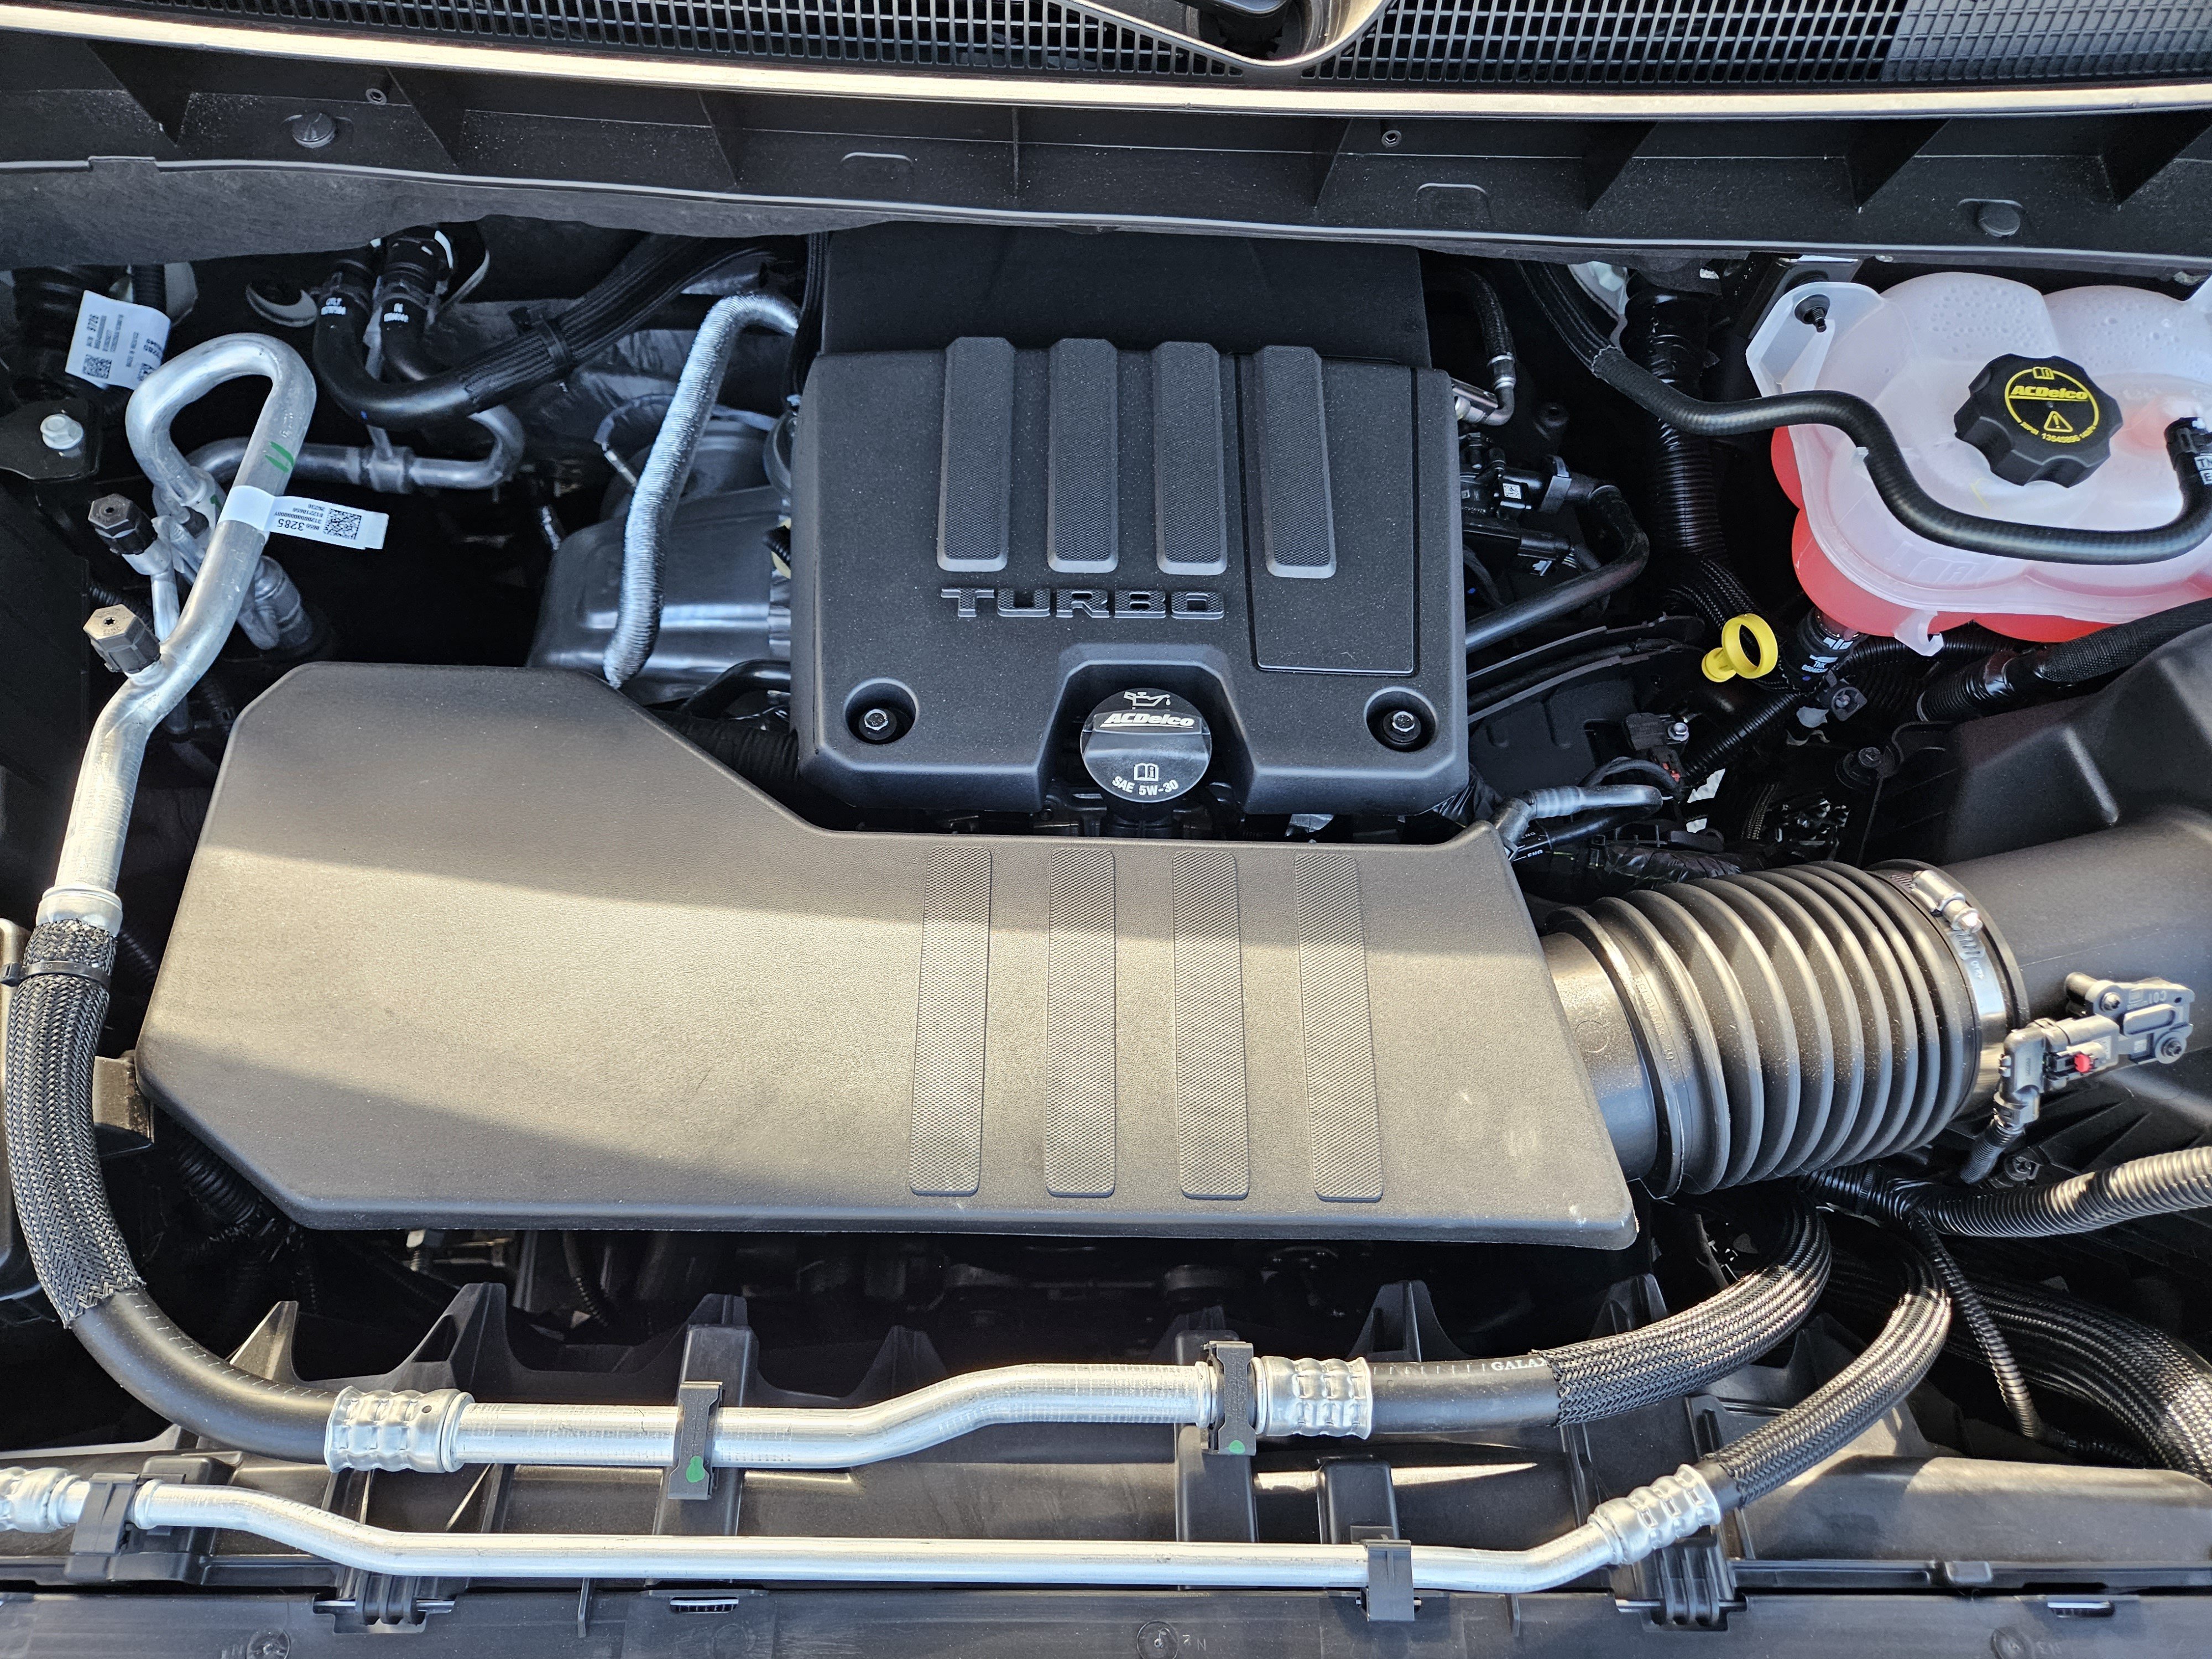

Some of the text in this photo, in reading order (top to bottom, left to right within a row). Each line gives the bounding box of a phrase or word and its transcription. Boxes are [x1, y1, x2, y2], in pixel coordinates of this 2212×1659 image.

[2010, 385, 2088, 400] ACDelco
[277, 518, 305, 531] 3285
[941, 587, 1224, 620] TURBO
[1104, 713, 1195, 727] ACDelco
[1112, 776, 1179, 796] SAE 5W-30
